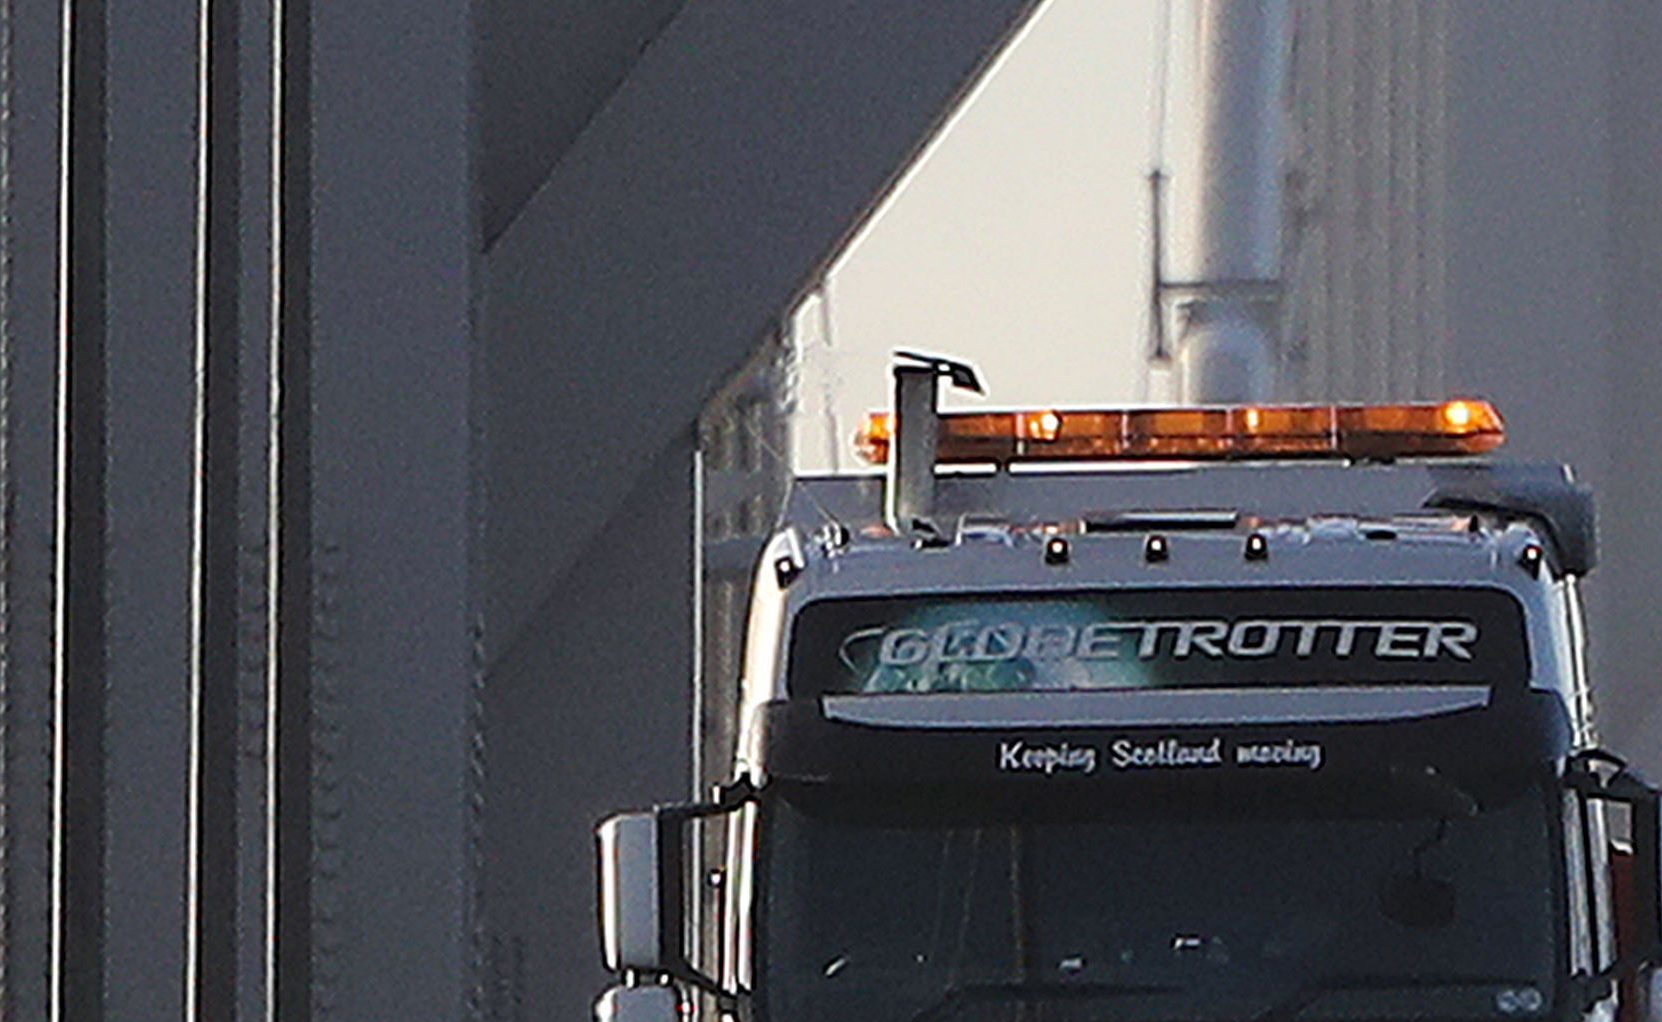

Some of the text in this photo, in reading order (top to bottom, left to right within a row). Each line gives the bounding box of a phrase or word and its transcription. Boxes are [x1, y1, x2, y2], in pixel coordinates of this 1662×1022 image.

[877, 619, 1478, 667] GLOBETROTTER
[1000, 738, 1322, 773] Keeping Scotland moving
